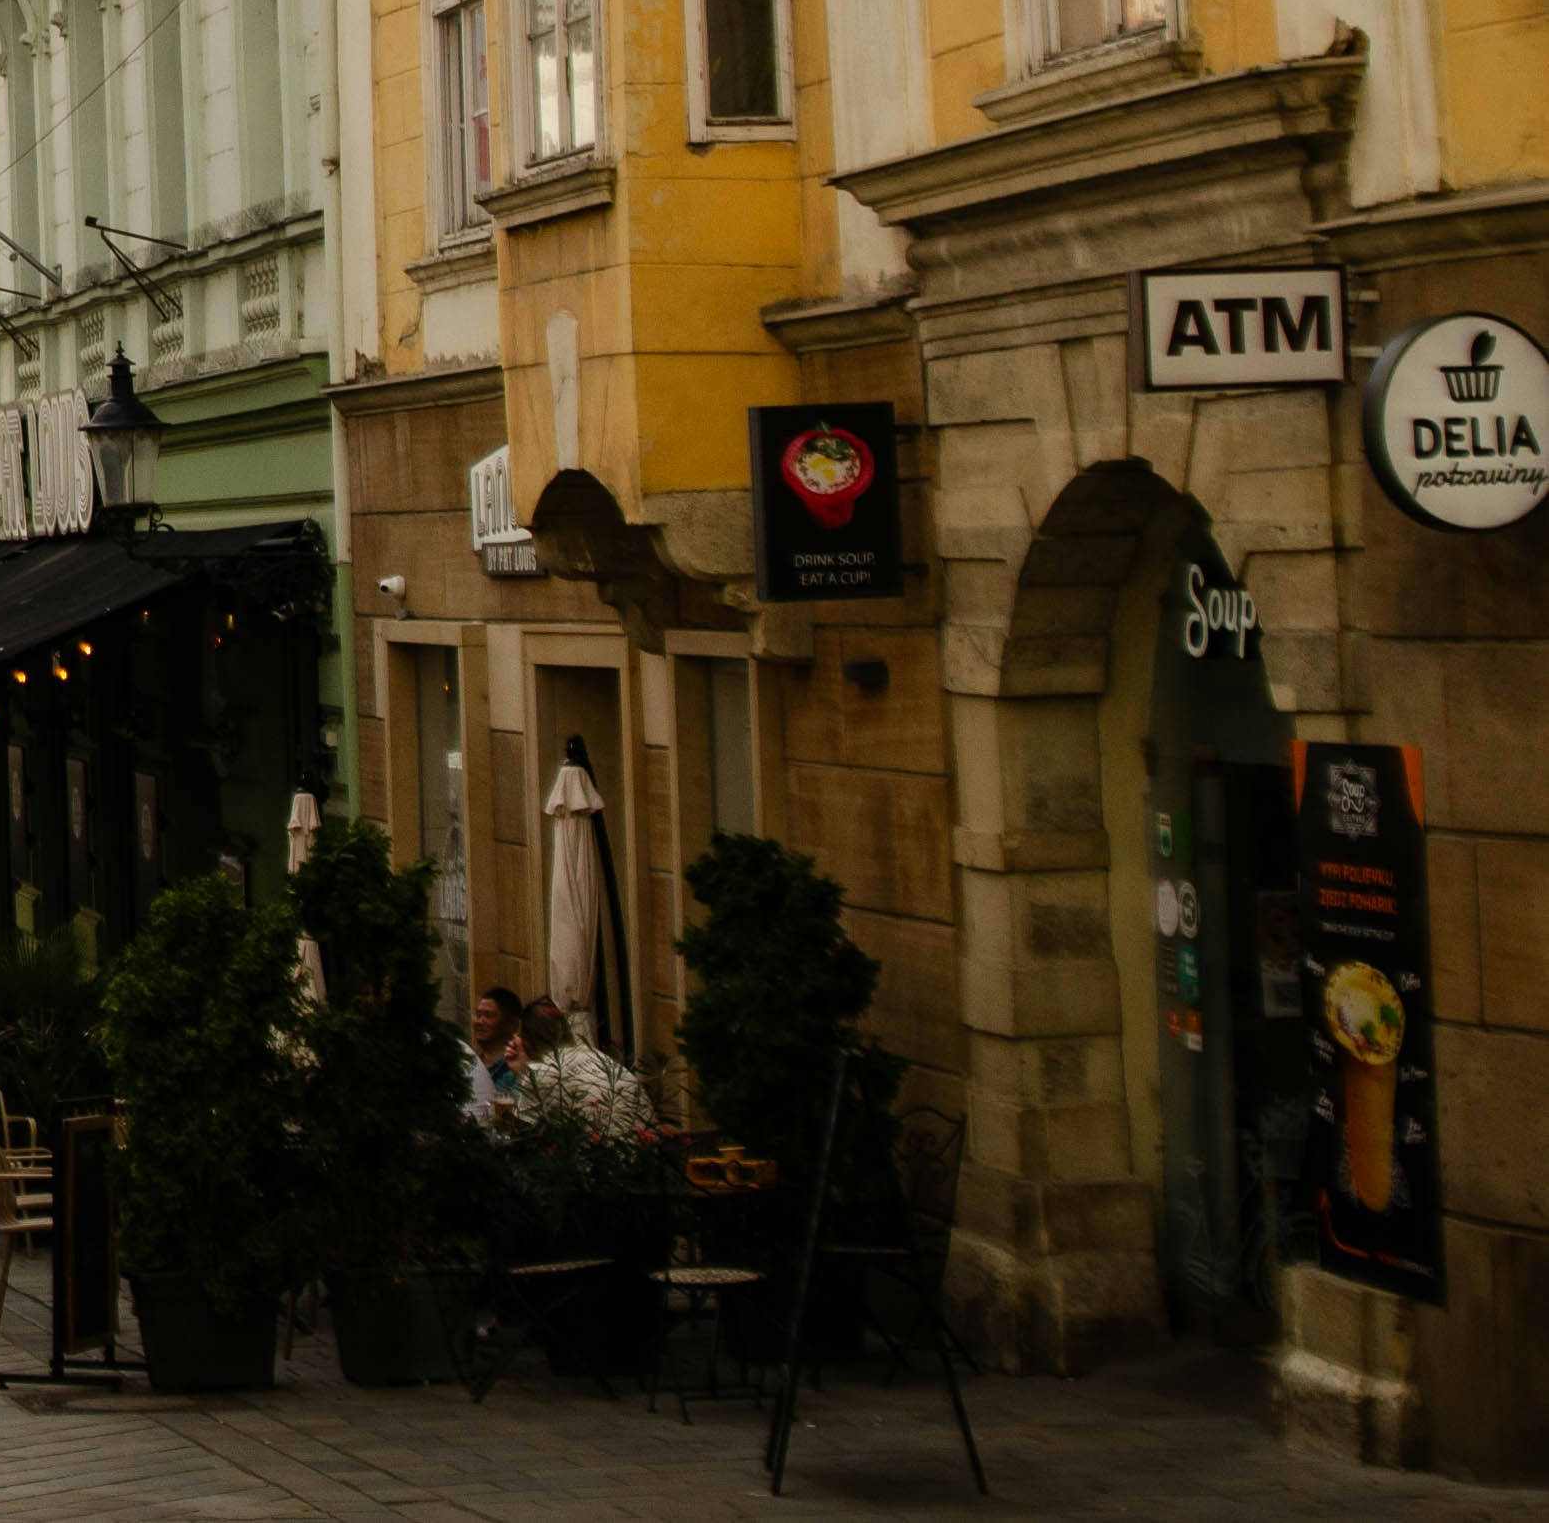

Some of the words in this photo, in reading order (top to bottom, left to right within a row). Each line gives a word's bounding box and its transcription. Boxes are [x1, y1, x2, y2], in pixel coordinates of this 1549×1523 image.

[1167, 294, 1331, 355] ATM
[1413, 414, 1541, 459] DELIA
[1413, 462, 1549, 498] potraviny
[794, 553, 836, 567] DRINK
[801, 573, 824, 586] EAT
[829, 573, 837, 584] A
[1185, 563, 1257, 659] Soup
